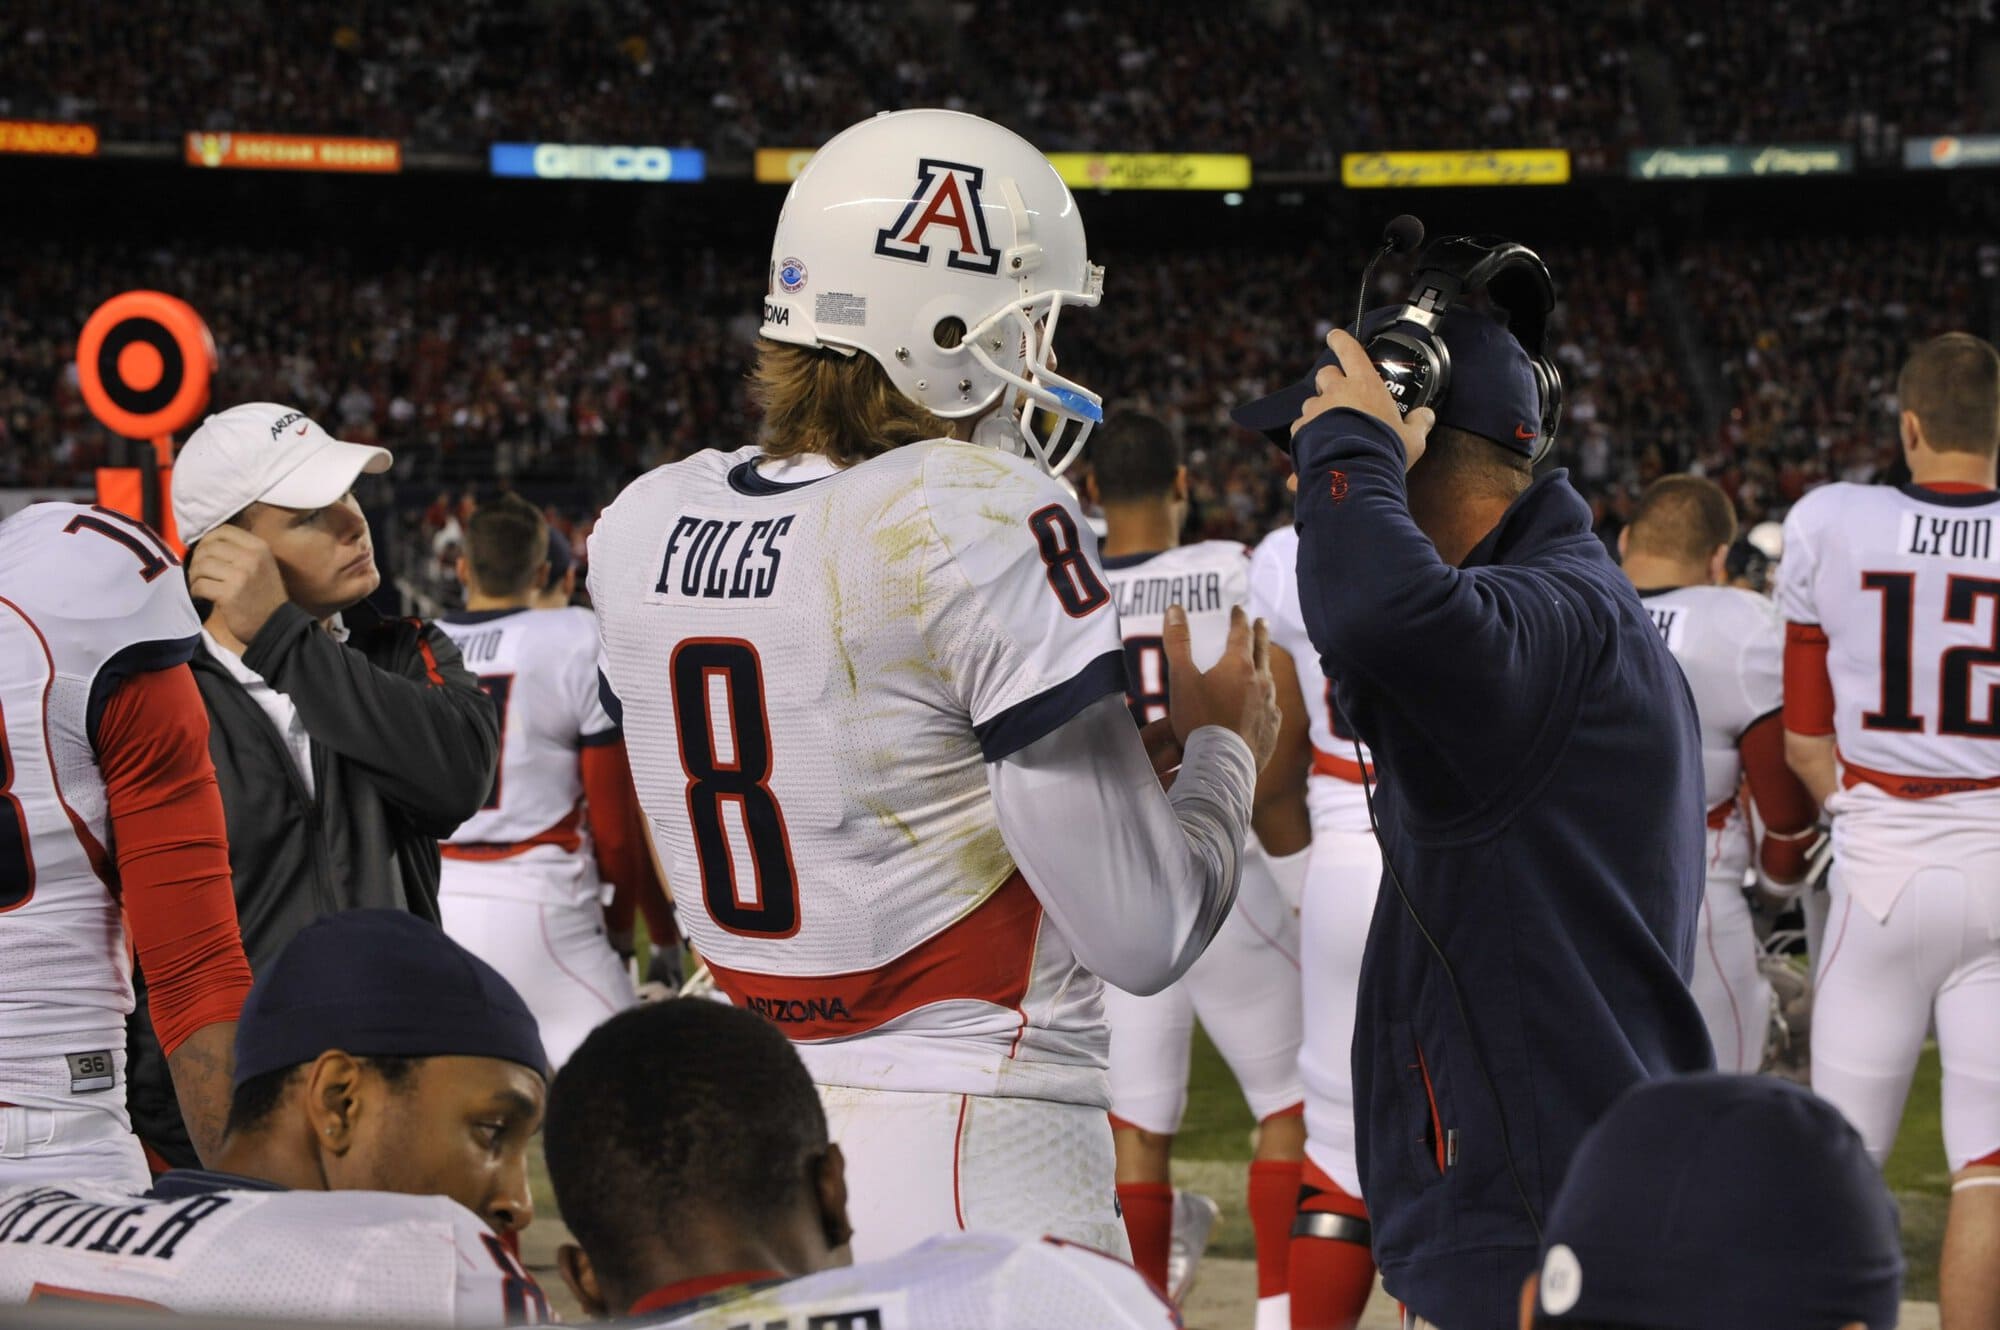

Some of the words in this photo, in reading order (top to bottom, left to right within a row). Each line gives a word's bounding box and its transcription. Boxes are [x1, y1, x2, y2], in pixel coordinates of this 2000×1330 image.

[873, 157, 1001, 275] A
[655, 514, 797, 600] FOLES
[1029, 502, 1111, 619] 8
[1908, 514, 1992, 560] LYON
[1112, 572, 1221, 617] LAMAKA
[1861, 570, 2000, 740] 12
[669, 636, 801, 940] 8
[746, 994, 853, 1023] ARIZONA
[78, 1056, 105, 1074] 36
